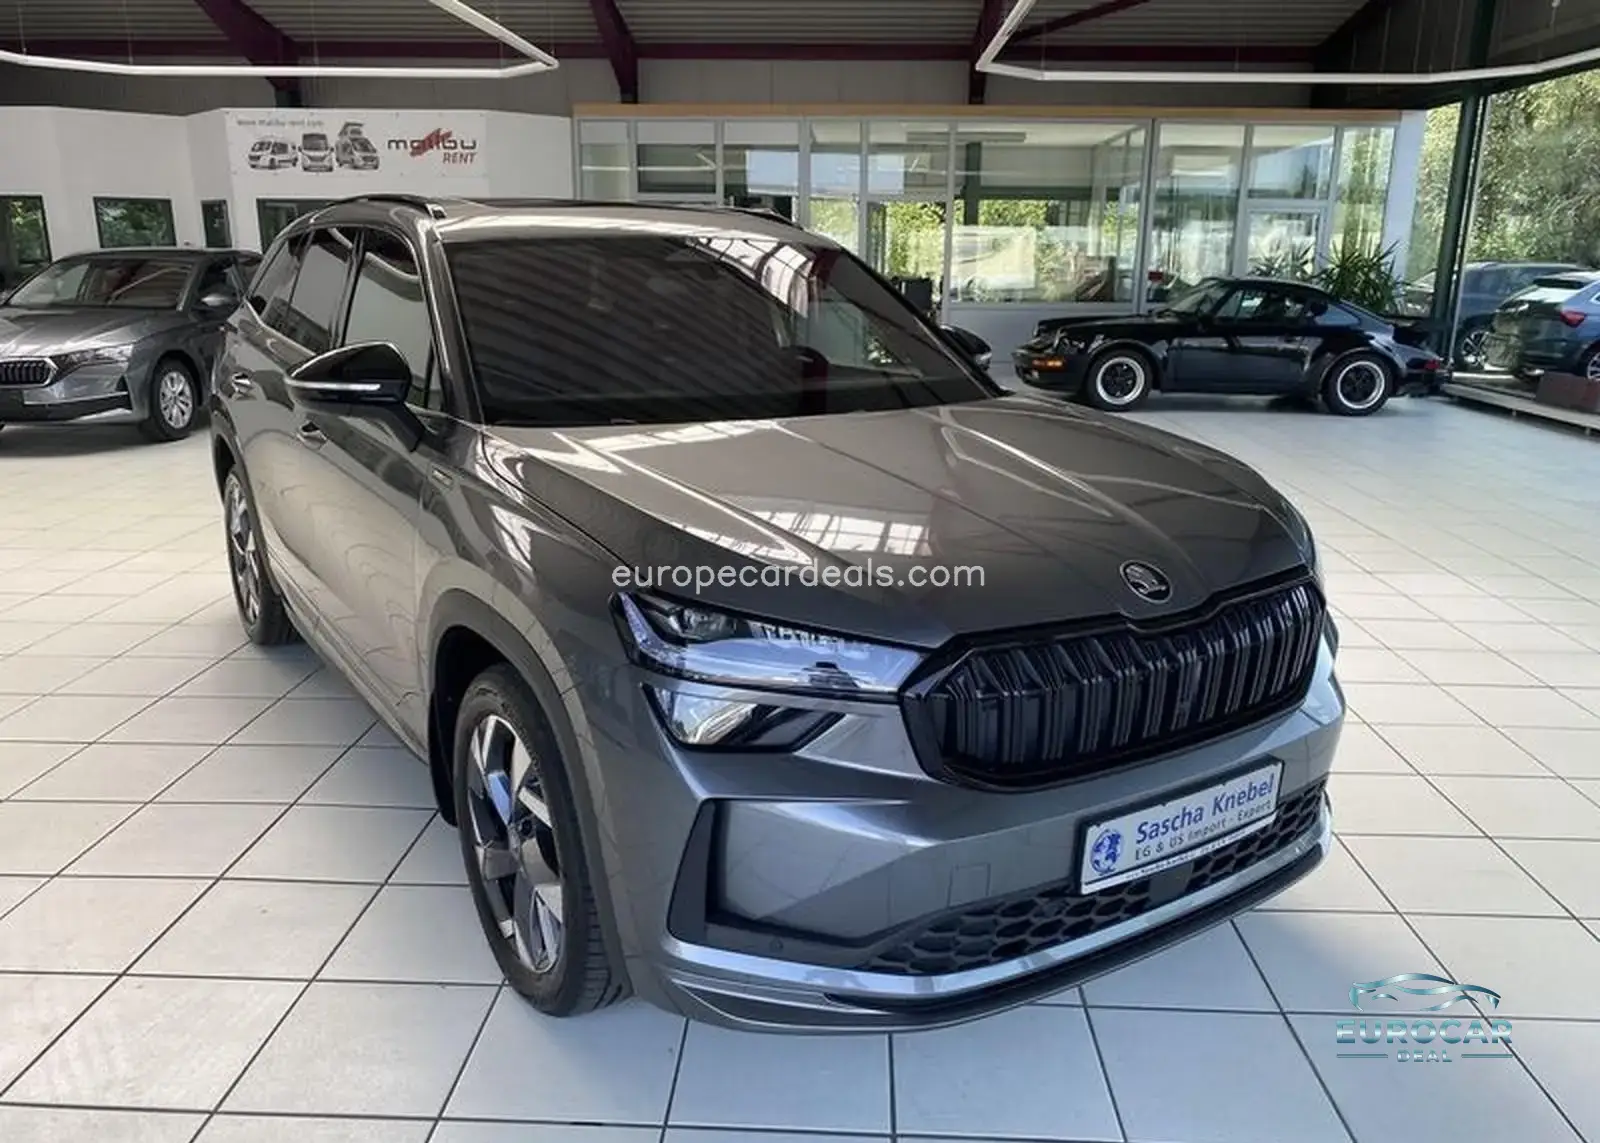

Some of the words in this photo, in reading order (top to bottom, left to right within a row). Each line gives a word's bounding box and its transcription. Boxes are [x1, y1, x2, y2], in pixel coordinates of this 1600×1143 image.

[442, 152, 477, 165] RENT
[1135, 844, 1151, 861] EG
[1156, 841, 1165, 855] &
[1169, 834, 1185, 849] US
[1187, 817, 1227, 843] Import
[1237, 799, 1272, 822] Export
[1136, 803, 1205, 845] Sascha
[1212, 772, 1275, 817] Knebel
